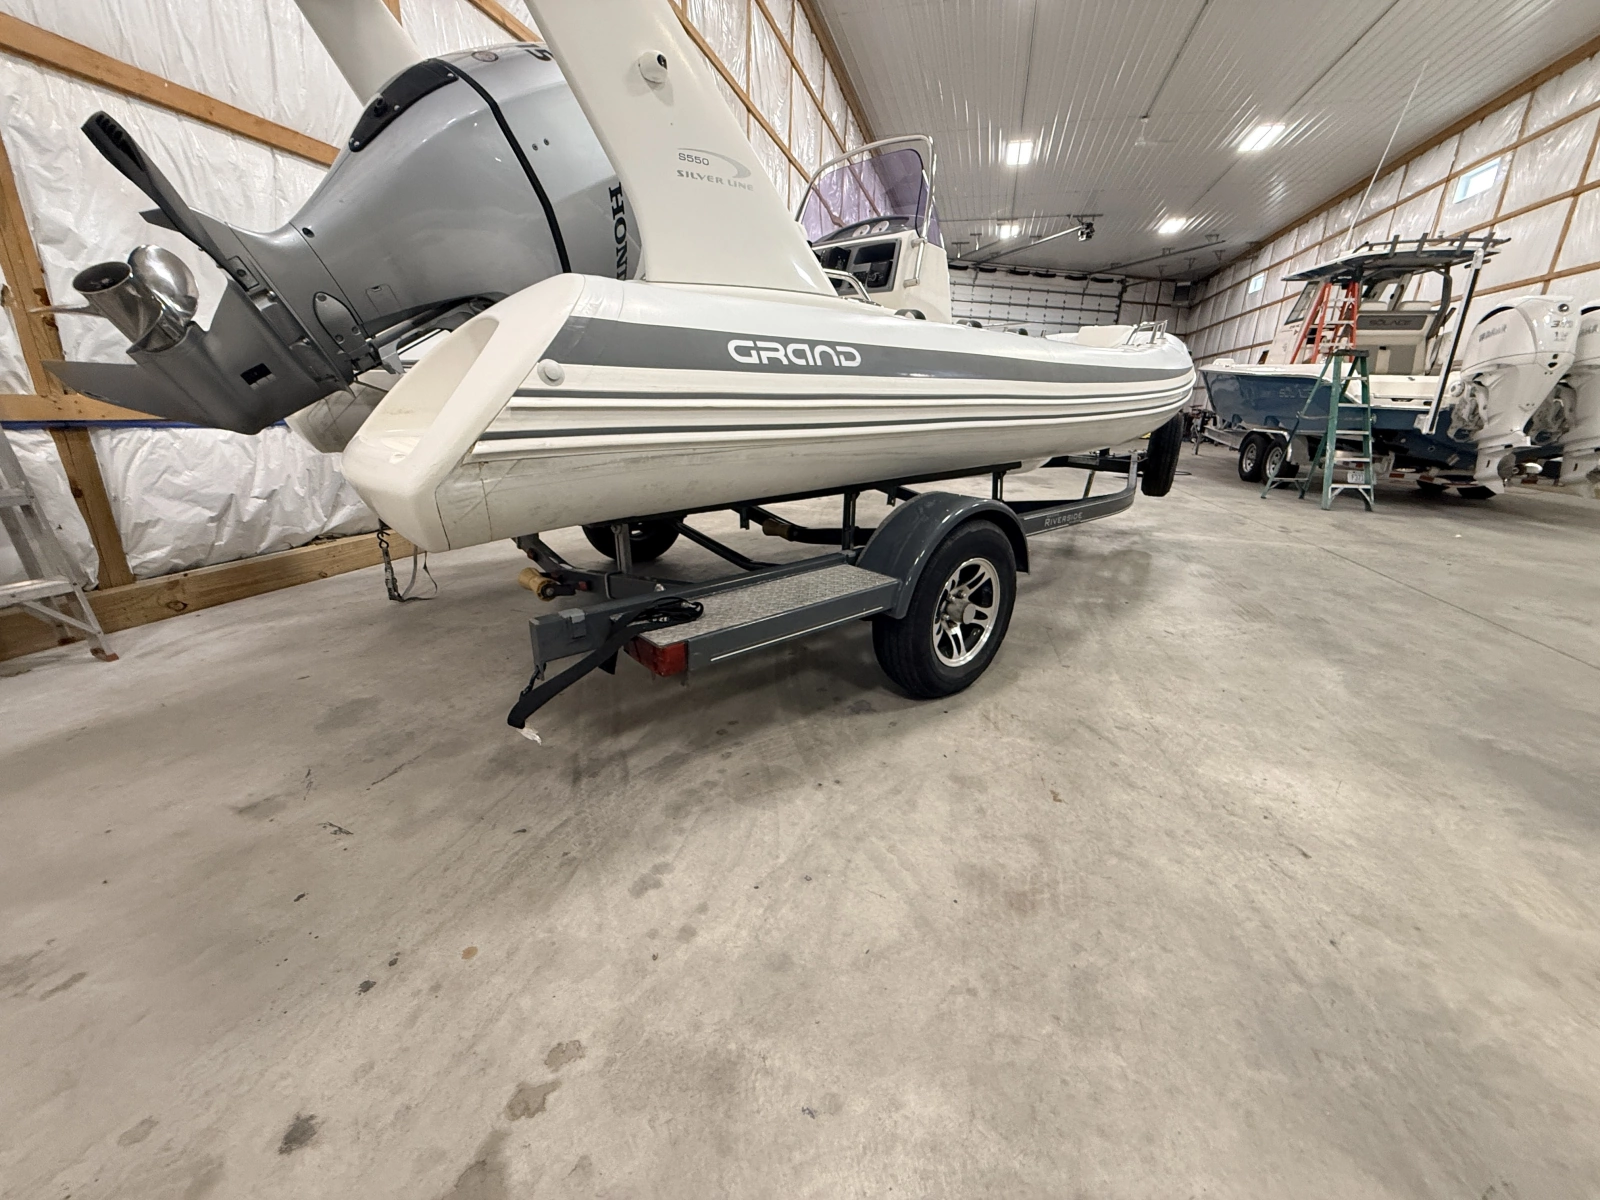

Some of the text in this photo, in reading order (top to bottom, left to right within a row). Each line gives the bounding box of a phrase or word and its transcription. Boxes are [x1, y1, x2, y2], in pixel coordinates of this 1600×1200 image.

[678, 152, 710, 166] S550
[676, 169, 754, 192] SILVER LINE
[727, 339, 862, 367] GRAND
[1044, 512, 1083, 526] RIVERSIDE
